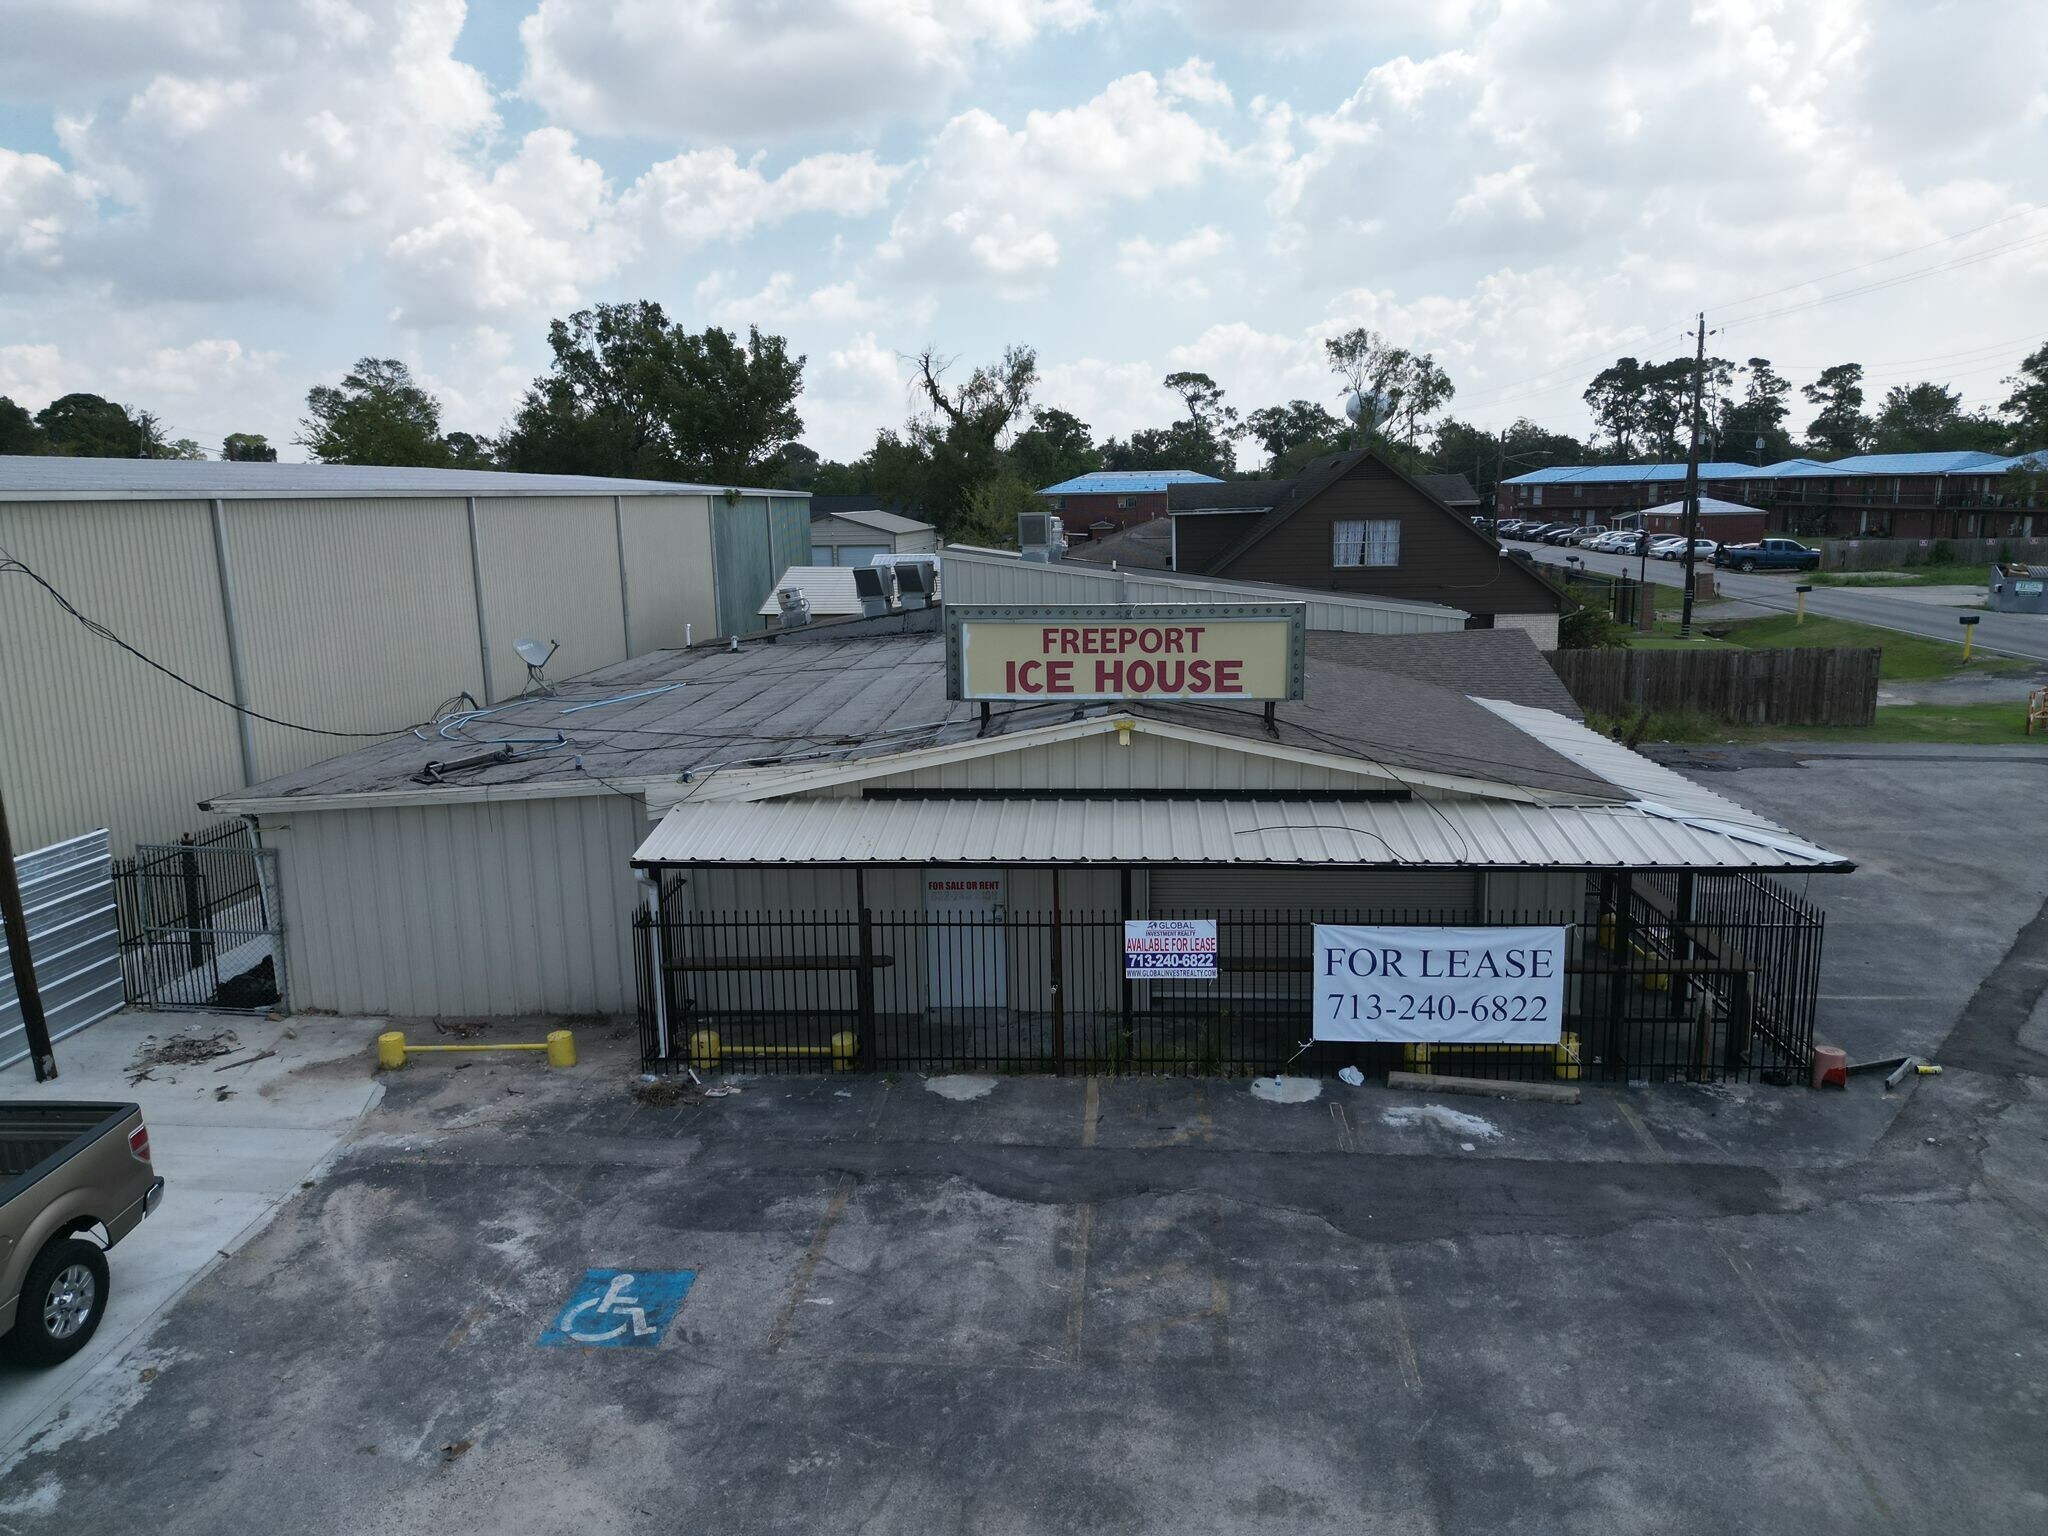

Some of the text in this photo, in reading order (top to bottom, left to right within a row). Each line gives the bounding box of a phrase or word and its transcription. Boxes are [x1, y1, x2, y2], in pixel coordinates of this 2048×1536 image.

[1042, 627, 1206, 654] FREEPORT
[1006, 659, 1243, 693] ICE HOUSE
[928, 881, 999, 890] FOR SALE OR RENT
[1159, 921, 1195, 930] GLOBAL
[1126, 937, 1216, 952] AVAILABLE FOR LEASE
[1128, 953, 1214, 968] 713-240-6822
[1323, 947, 1554, 979] FOR LEASE
[1126, 969, 1217, 977] WWW.GLOBALINVESTREALTY.COM
[1327, 993, 1548, 1022] 713-240-6822
